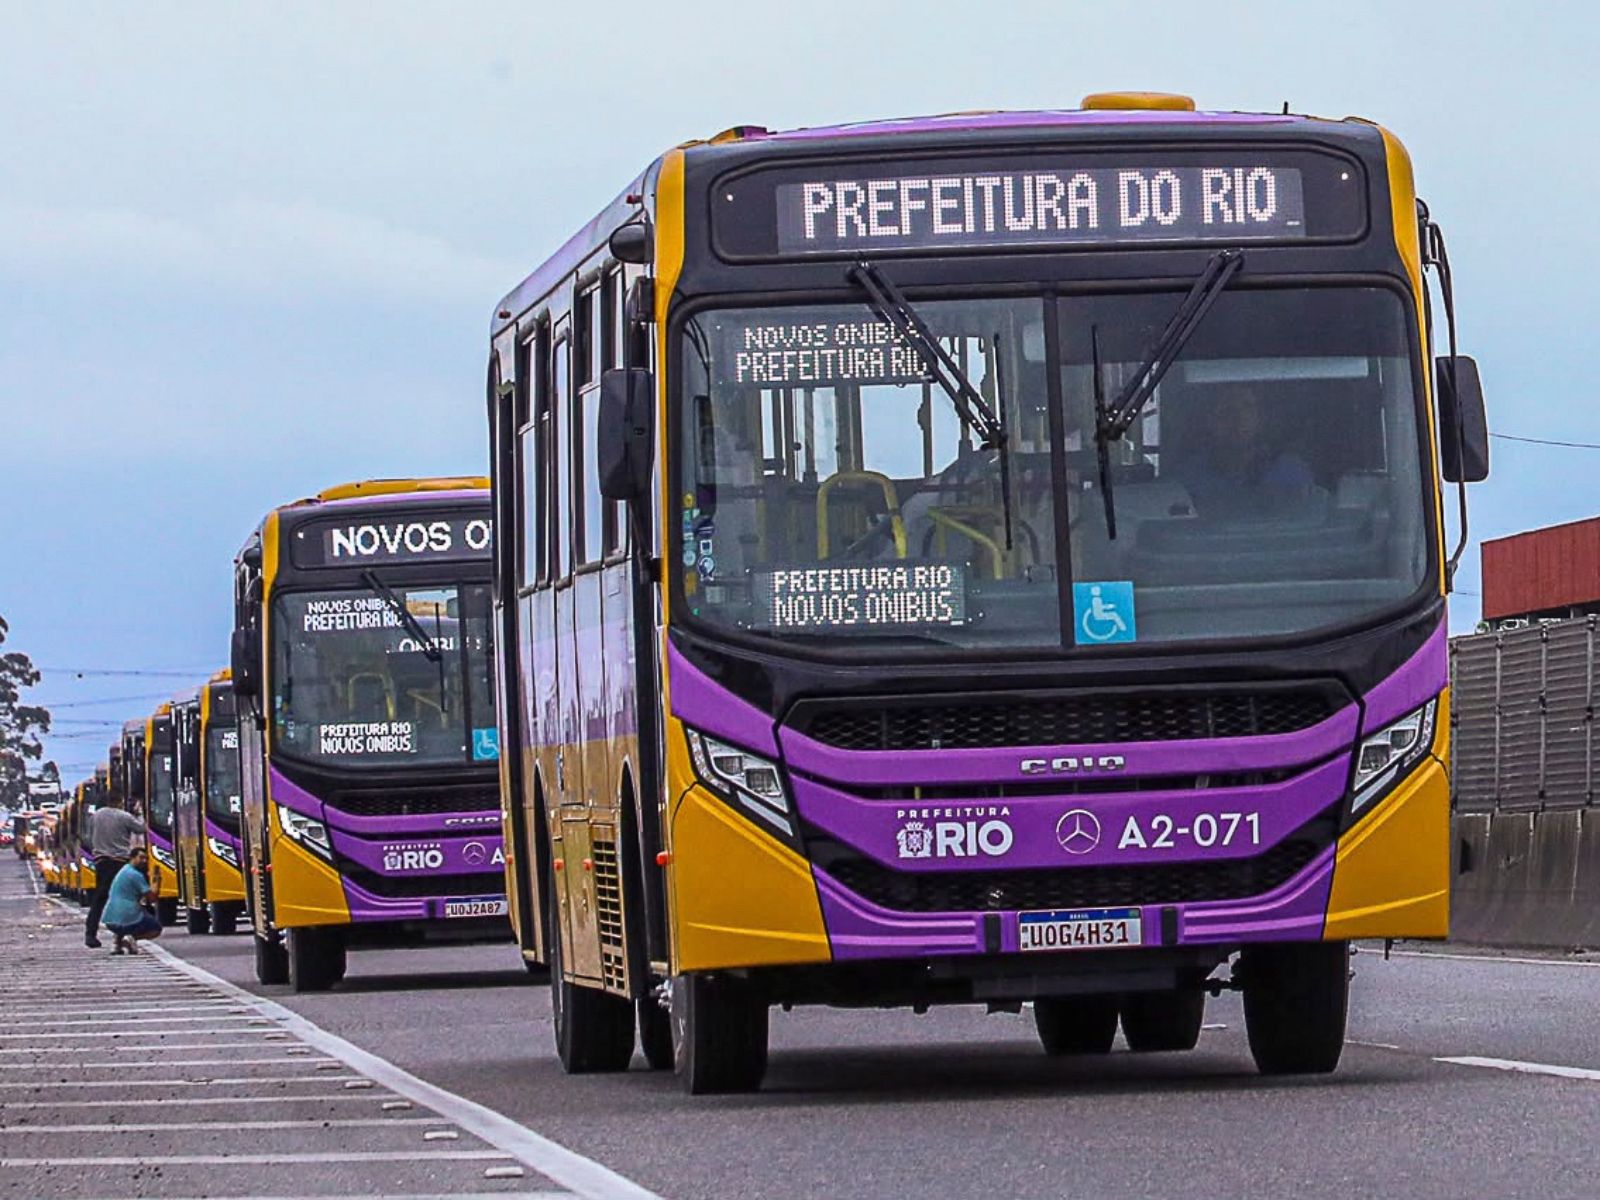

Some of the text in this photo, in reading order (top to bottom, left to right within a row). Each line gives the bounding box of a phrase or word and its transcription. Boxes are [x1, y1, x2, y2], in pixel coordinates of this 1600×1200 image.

[803, 166, 1277, 239] PREFEITURA DO RIO
[744, 324, 828, 349] NOVOS
[736, 347, 885, 383] PREFEITURA
[332, 521, 452, 557] NOVOS
[774, 565, 952, 594] PREFEITURA RIO
[307, 600, 352, 614] NOVOS
[774, 591, 953, 626] NOVOS ONIBUS
[303, 612, 382, 632] PREFEITURA
[319, 721, 411, 737] PREFEITURA RIO
[320, 734, 411, 754] NOVOS ONIBUS
[897, 807, 1011, 818] PREFEITURA
[936, 819, 1013, 857] RIO
[1117, 812, 1261, 849] A2-071
[402, 849, 443, 869] RIO
[1030, 921, 1129, 946] UOG4H31
